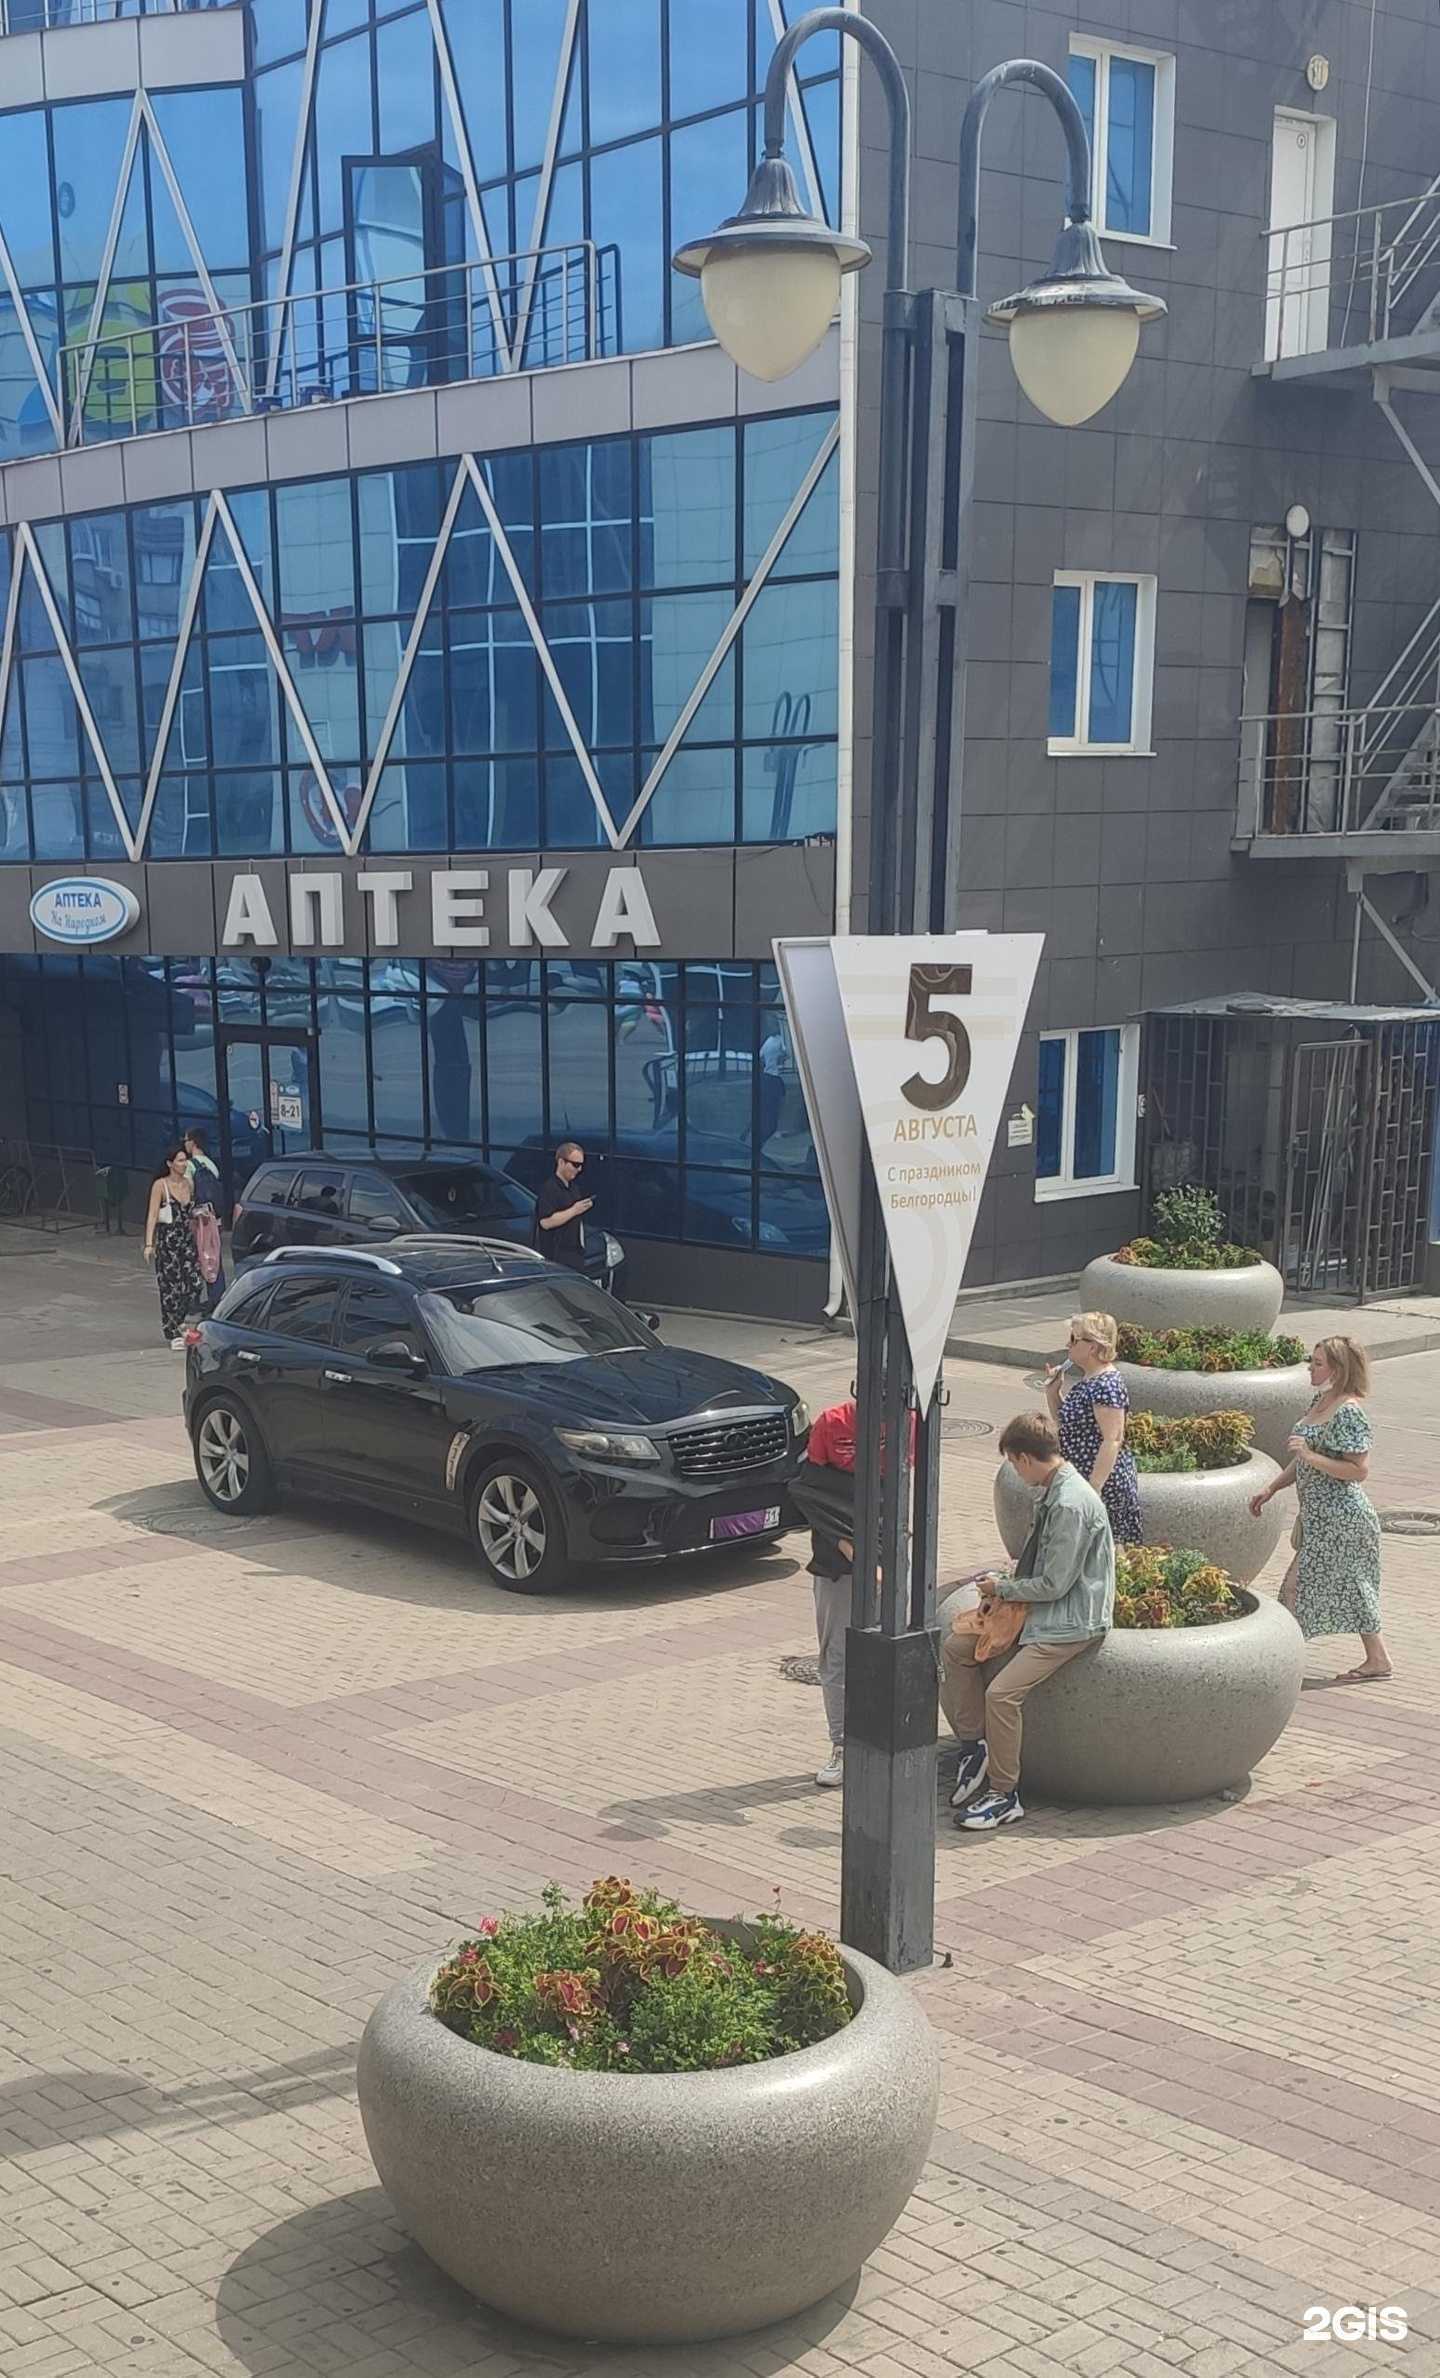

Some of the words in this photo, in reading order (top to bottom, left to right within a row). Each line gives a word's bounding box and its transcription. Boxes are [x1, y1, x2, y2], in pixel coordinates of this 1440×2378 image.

[55, 893, 102, 908] АПТЕКА
[222, 867, 661, 947] АПТЕКА
[900, 963, 973, 1112] 5
[280, 1104, 300, 1118] 8-21
[894, 1115, 977, 1141] АВГУСТА
[887, 1166, 896, 1182] С
[901, 1162, 981, 1183] праздником
[890, 1185, 977, 1209] Белгородцы!
